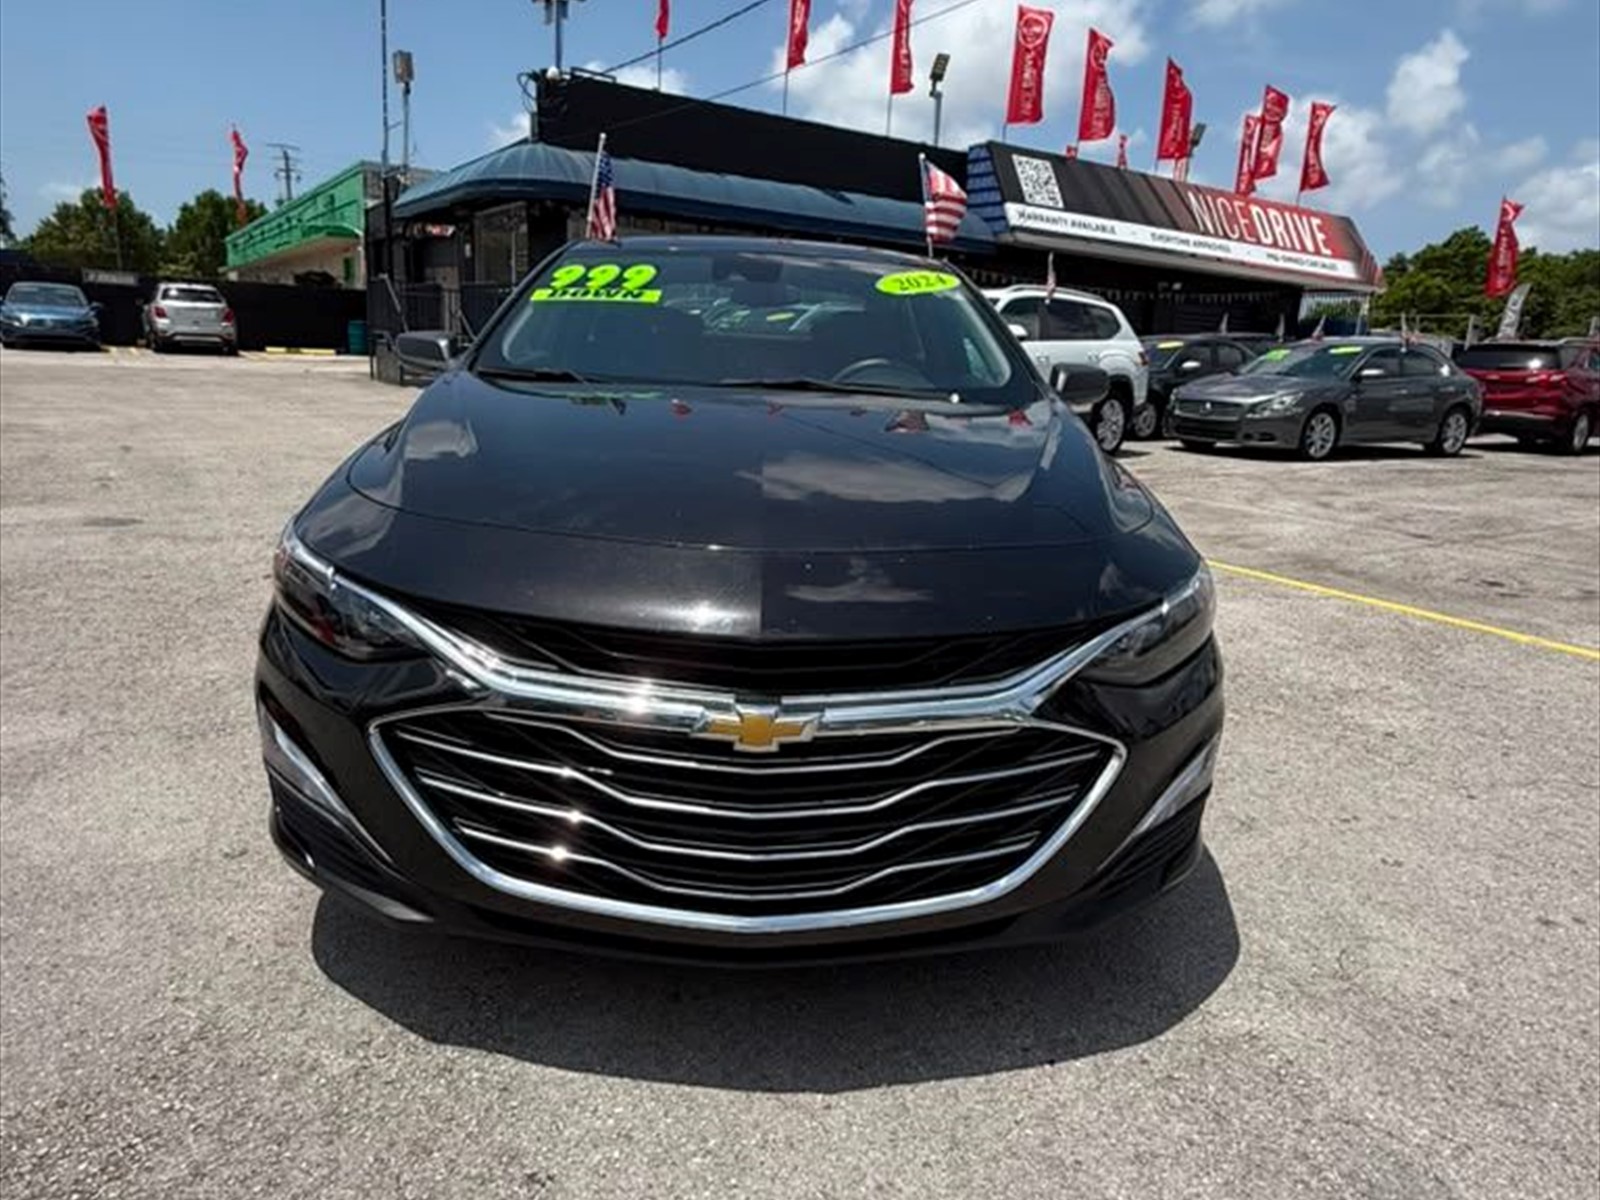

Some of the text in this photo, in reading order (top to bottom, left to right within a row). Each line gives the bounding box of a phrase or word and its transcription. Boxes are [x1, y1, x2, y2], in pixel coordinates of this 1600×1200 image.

[1188, 191, 1332, 256] NICEDRIVE
[549, 263, 657, 290] 999
[892, 273, 948, 291] 2024
[548, 286, 645, 299] DOWN
